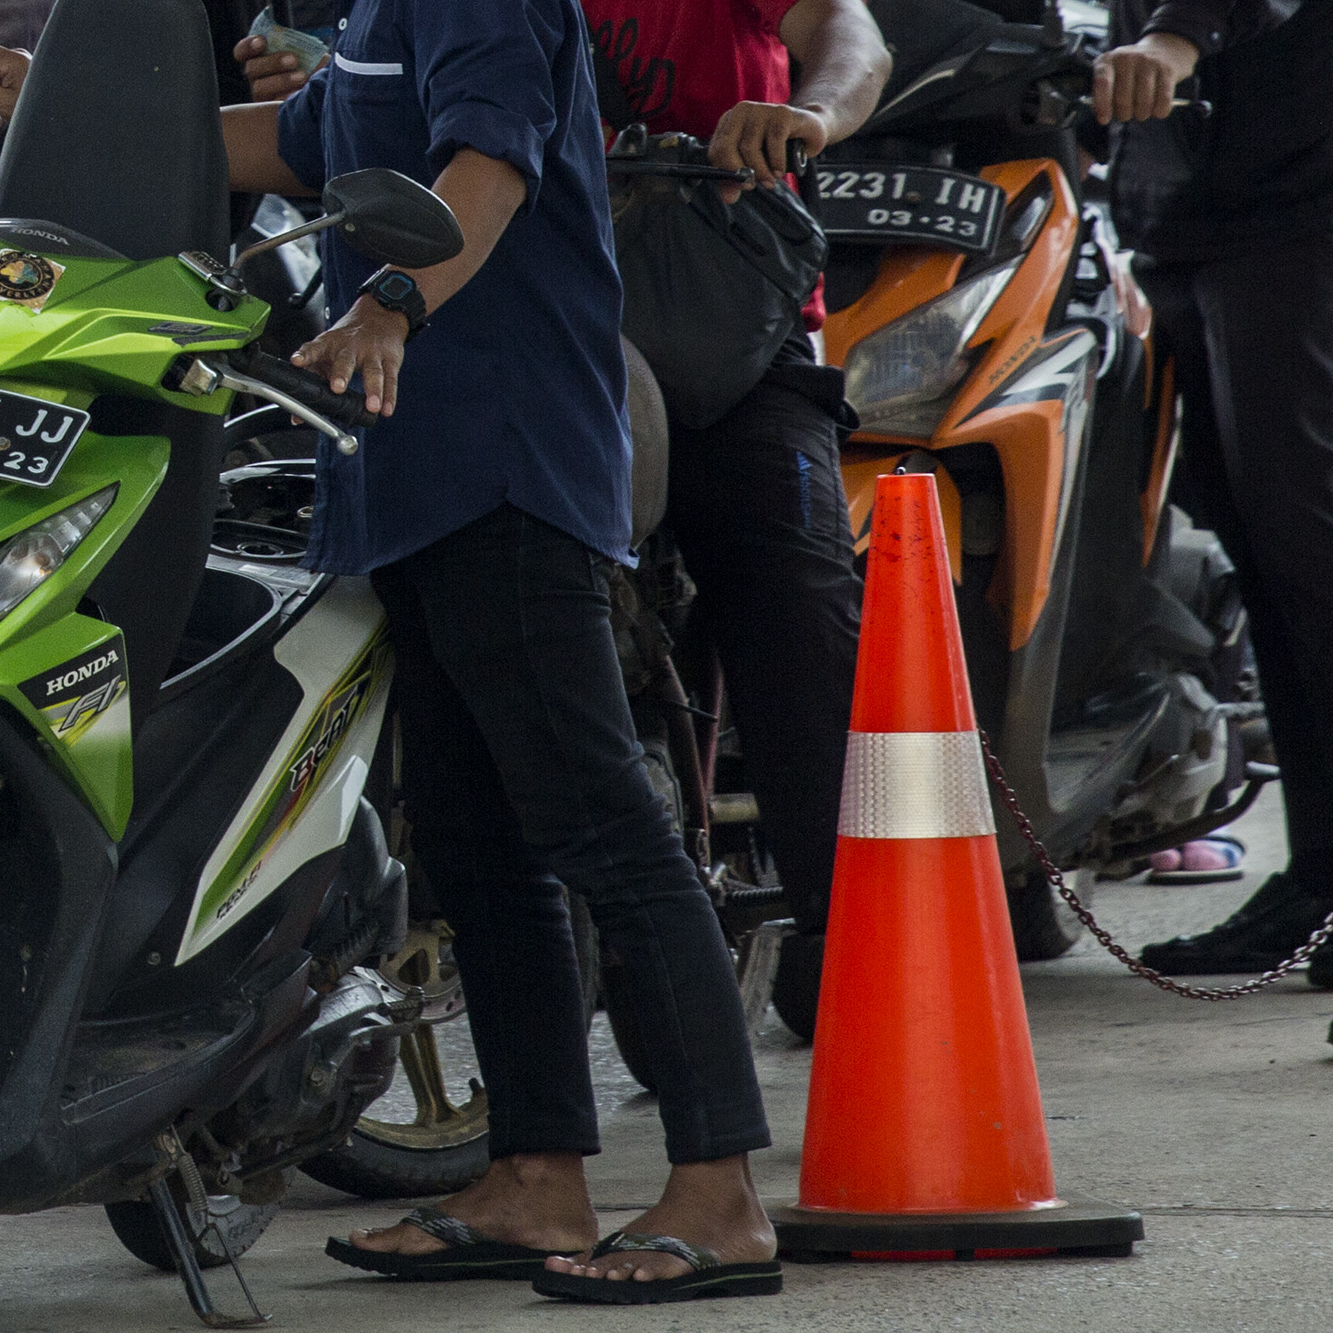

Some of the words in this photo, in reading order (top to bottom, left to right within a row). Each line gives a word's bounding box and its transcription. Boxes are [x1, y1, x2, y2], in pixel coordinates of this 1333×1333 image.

[817, 172, 907, 200] 2231
[935, 178, 986, 213] IH
[11, 228, 70, 245] HONDA
[15, 409, 74, 443] JJ
[46, 650, 119, 696] HONDA
[58, 674, 122, 732] FI
